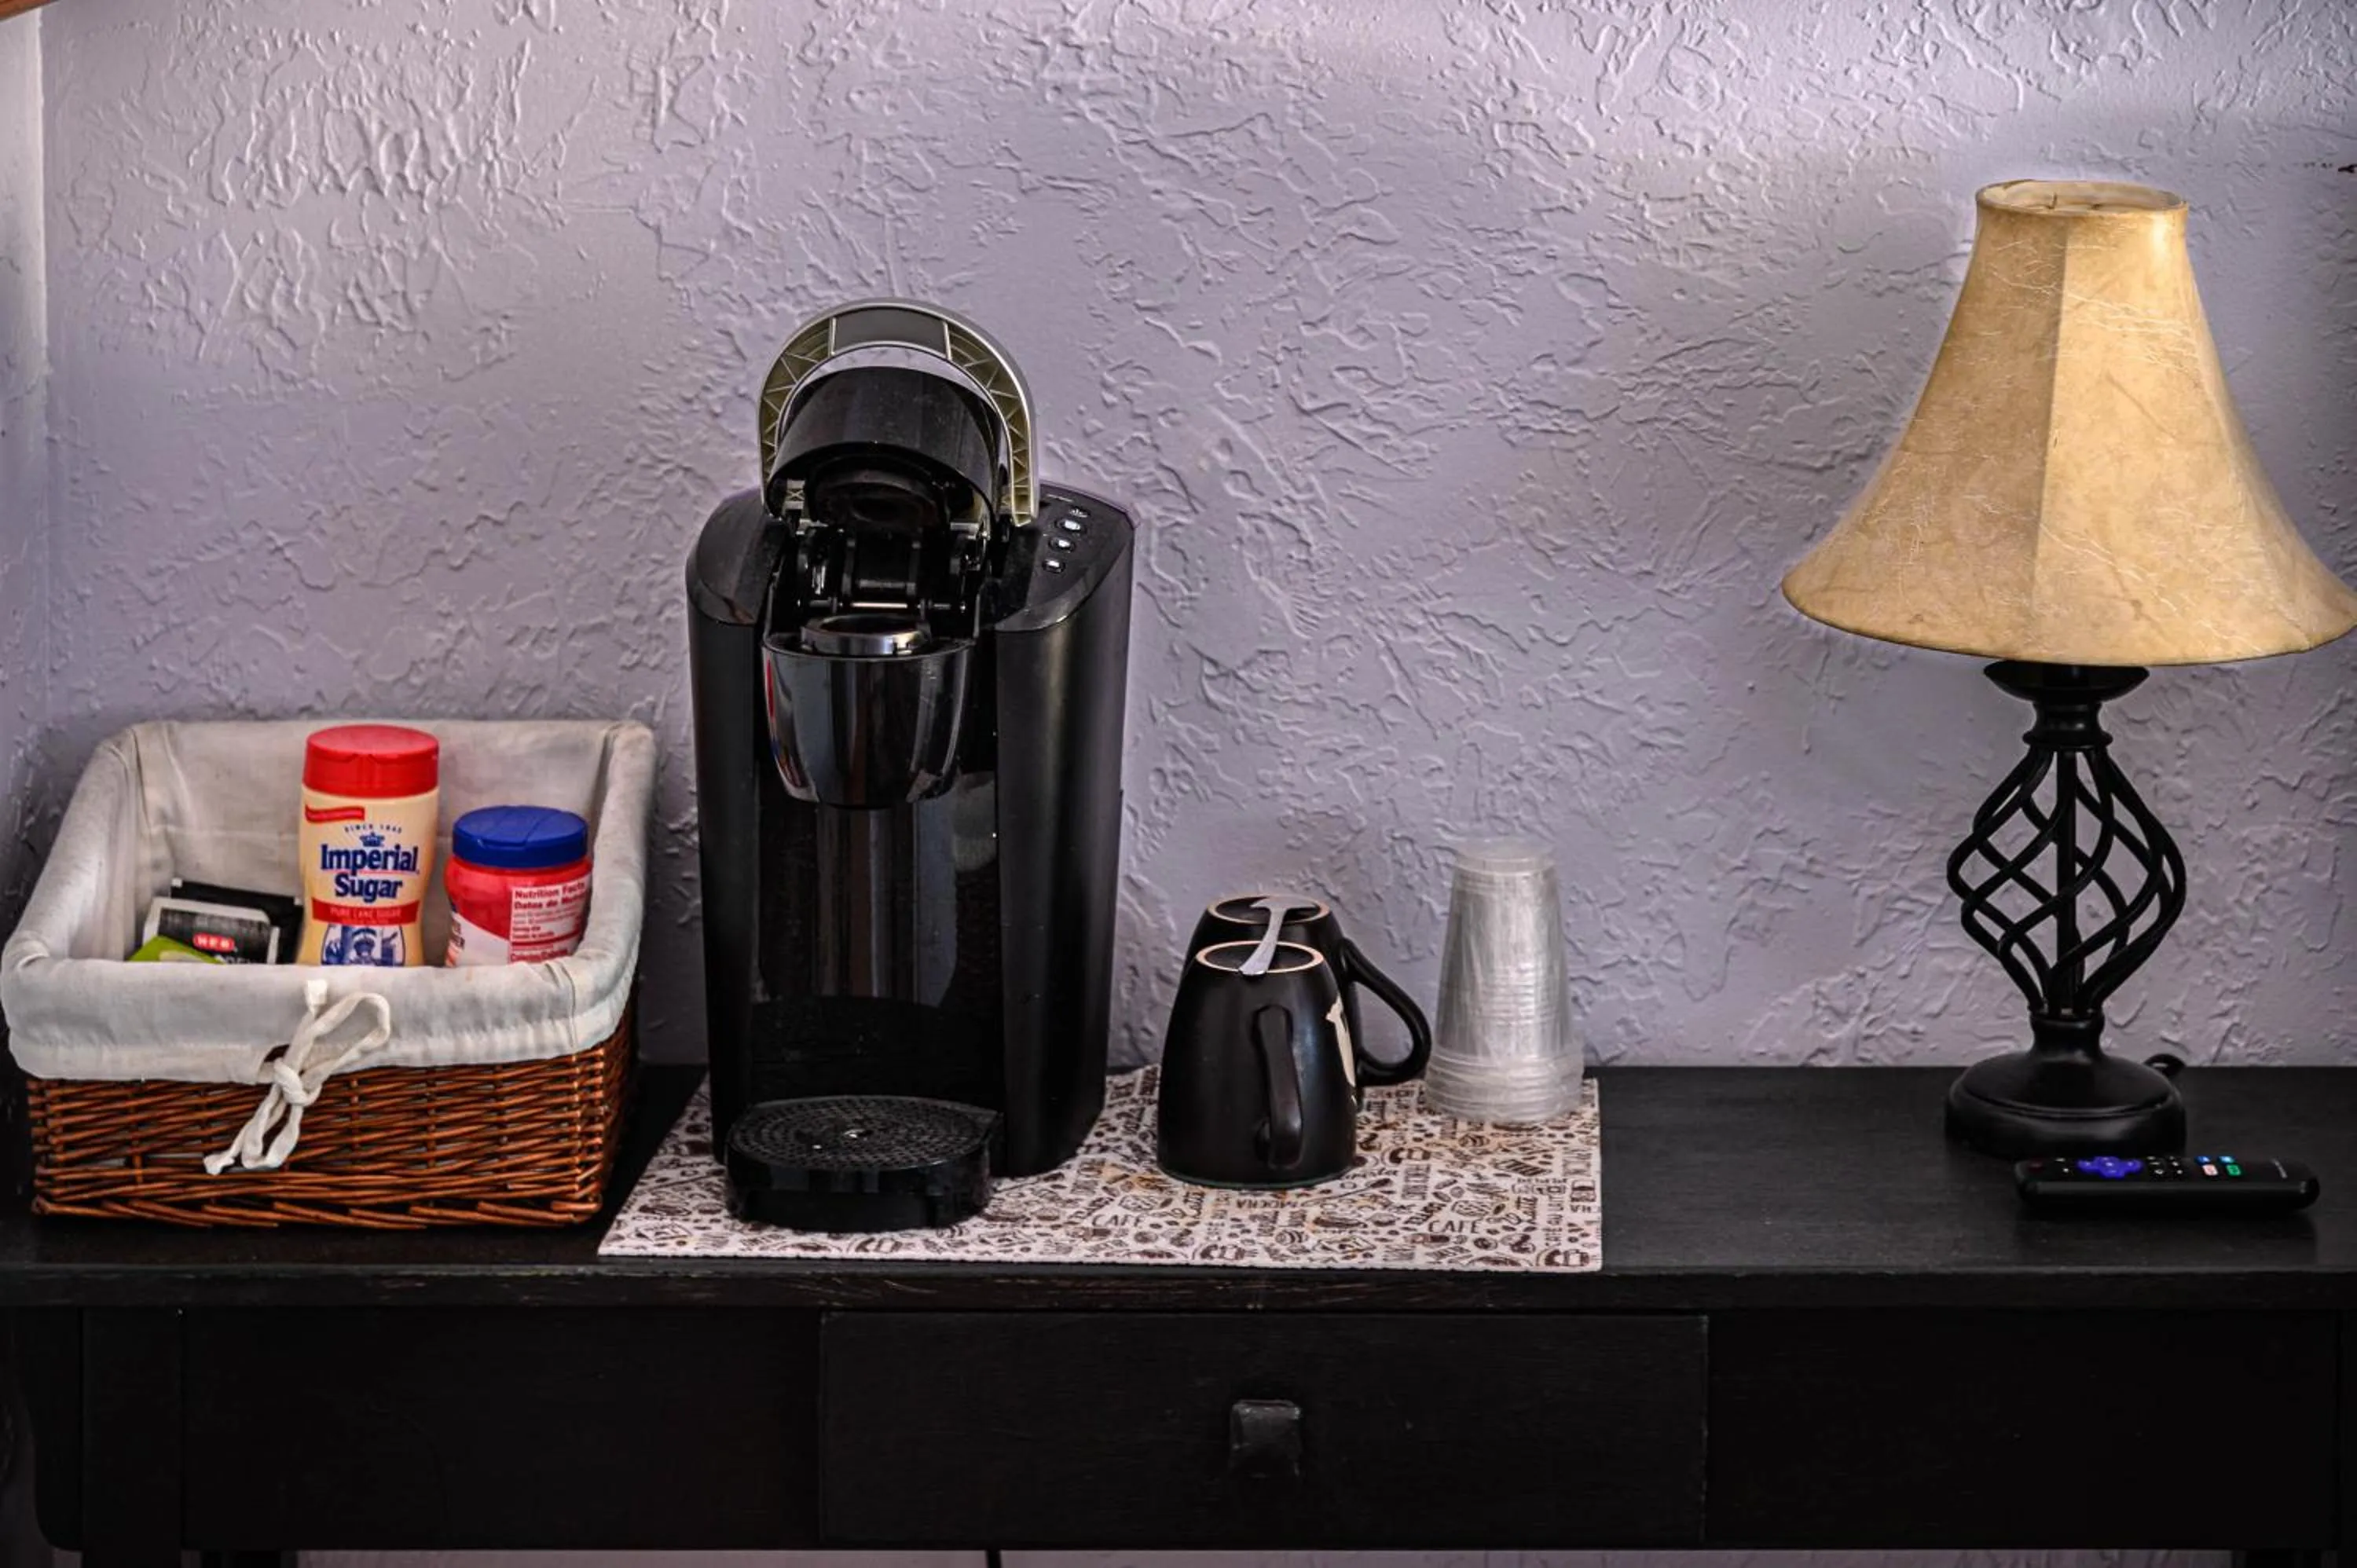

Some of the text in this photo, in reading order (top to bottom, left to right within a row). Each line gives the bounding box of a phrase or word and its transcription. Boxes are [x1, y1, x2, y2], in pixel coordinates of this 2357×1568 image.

[321, 843, 419, 876] Imperial
[335, 873, 403, 903] Sugar
[515, 888, 559, 899] Nutrition
